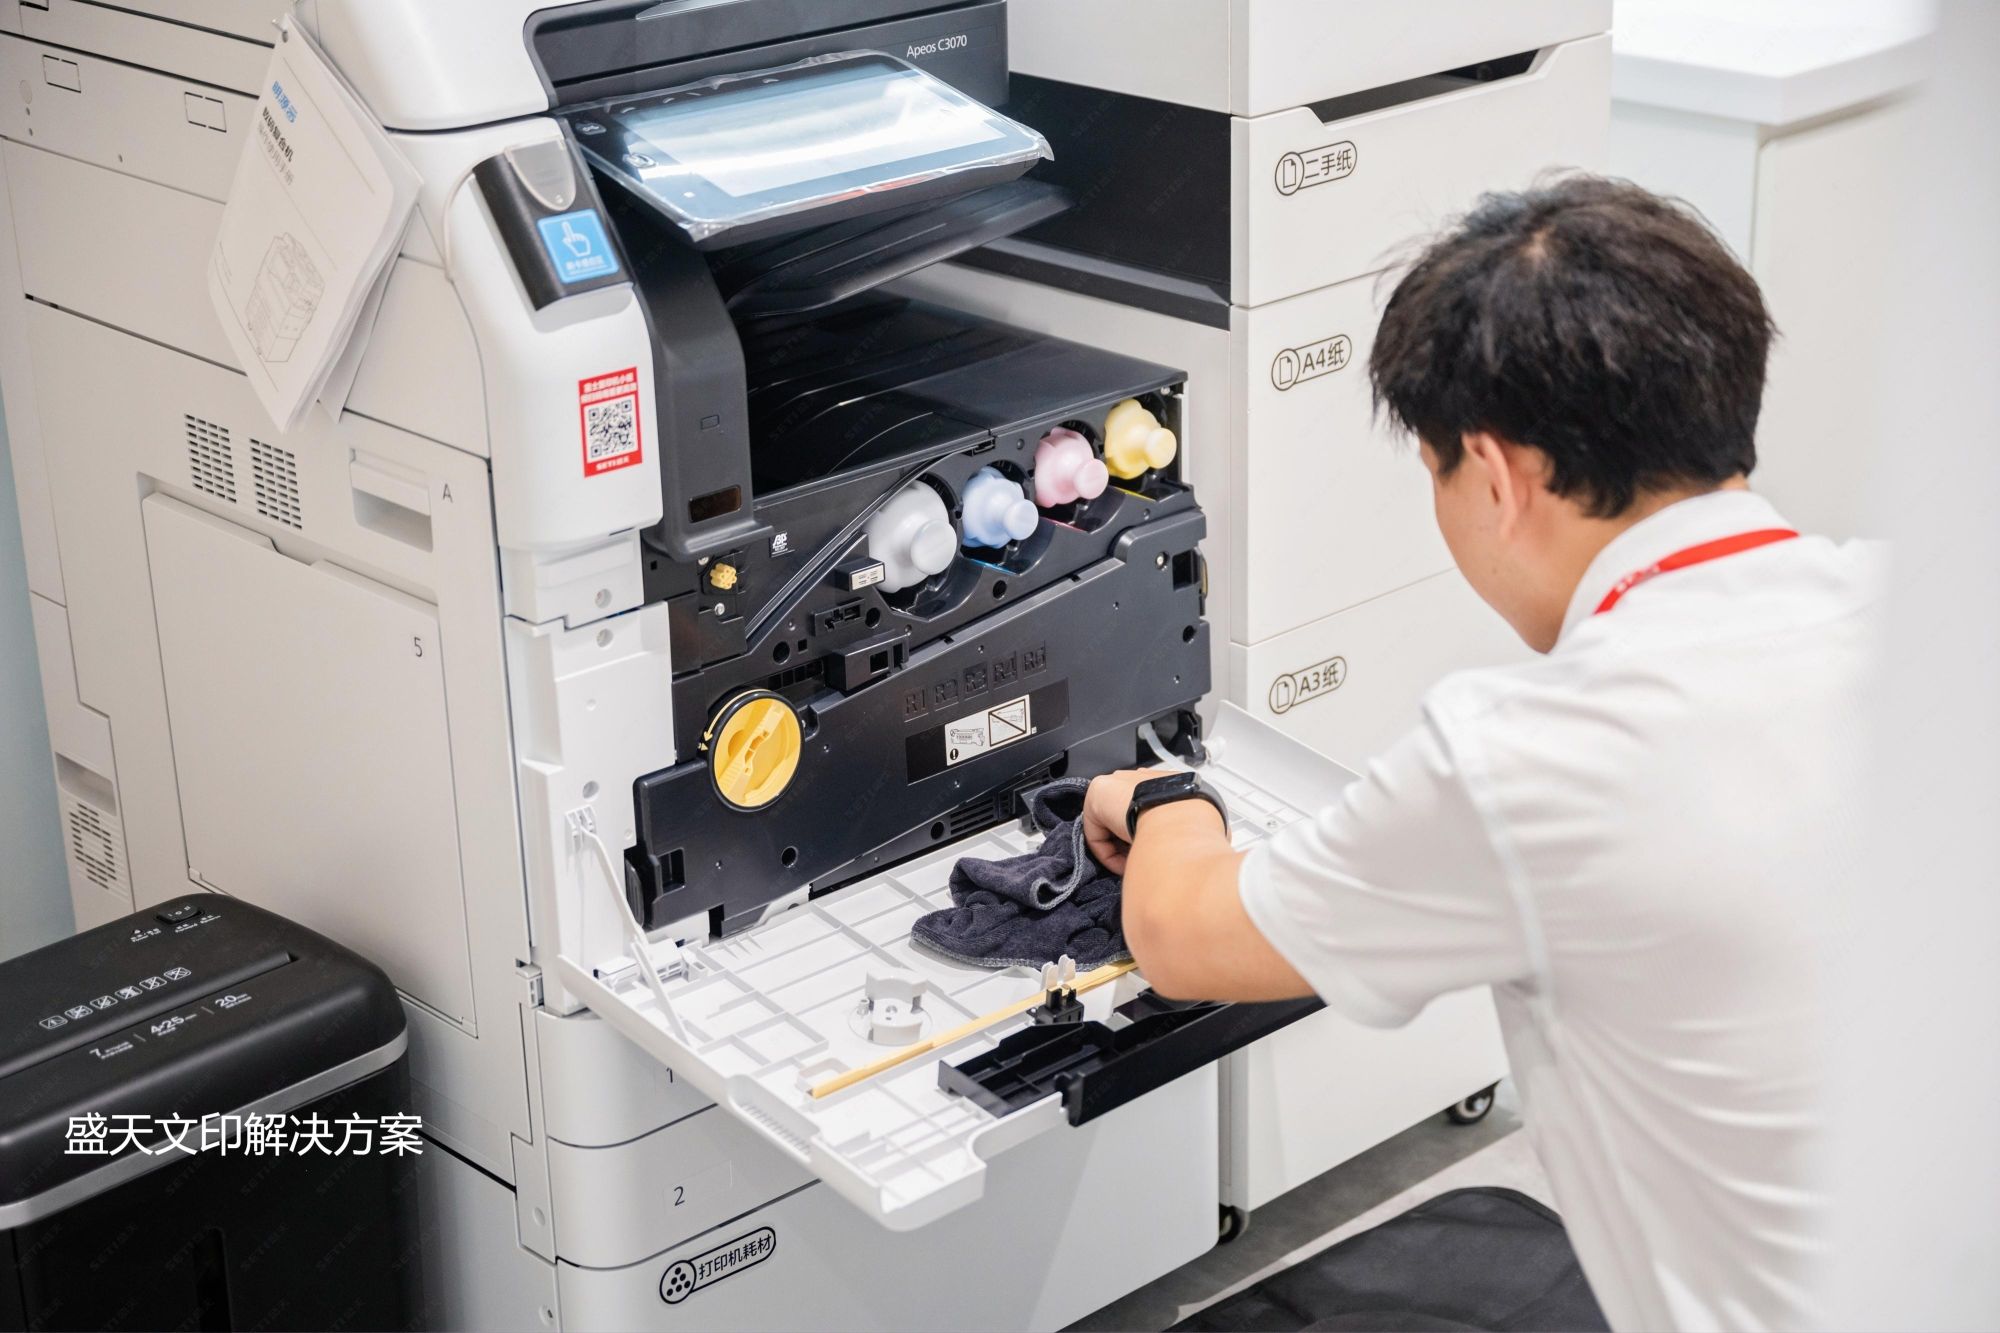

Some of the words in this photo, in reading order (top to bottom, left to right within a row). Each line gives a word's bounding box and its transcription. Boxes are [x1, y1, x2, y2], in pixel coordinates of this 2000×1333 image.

[906, 43, 937, 59] Apeos
[937, 34, 968, 51] C3070
[1304, 148, 1352, 179] 二手纸
[1302, 340, 1344, 374] A4纸
[442, 483, 454, 504] A
[413, 636, 424, 658] 5
[1298, 661, 1339, 697] A3纸
[673, 1185, 686, 1207] 2
[698, 1234, 772, 1281] 打印机耗材
